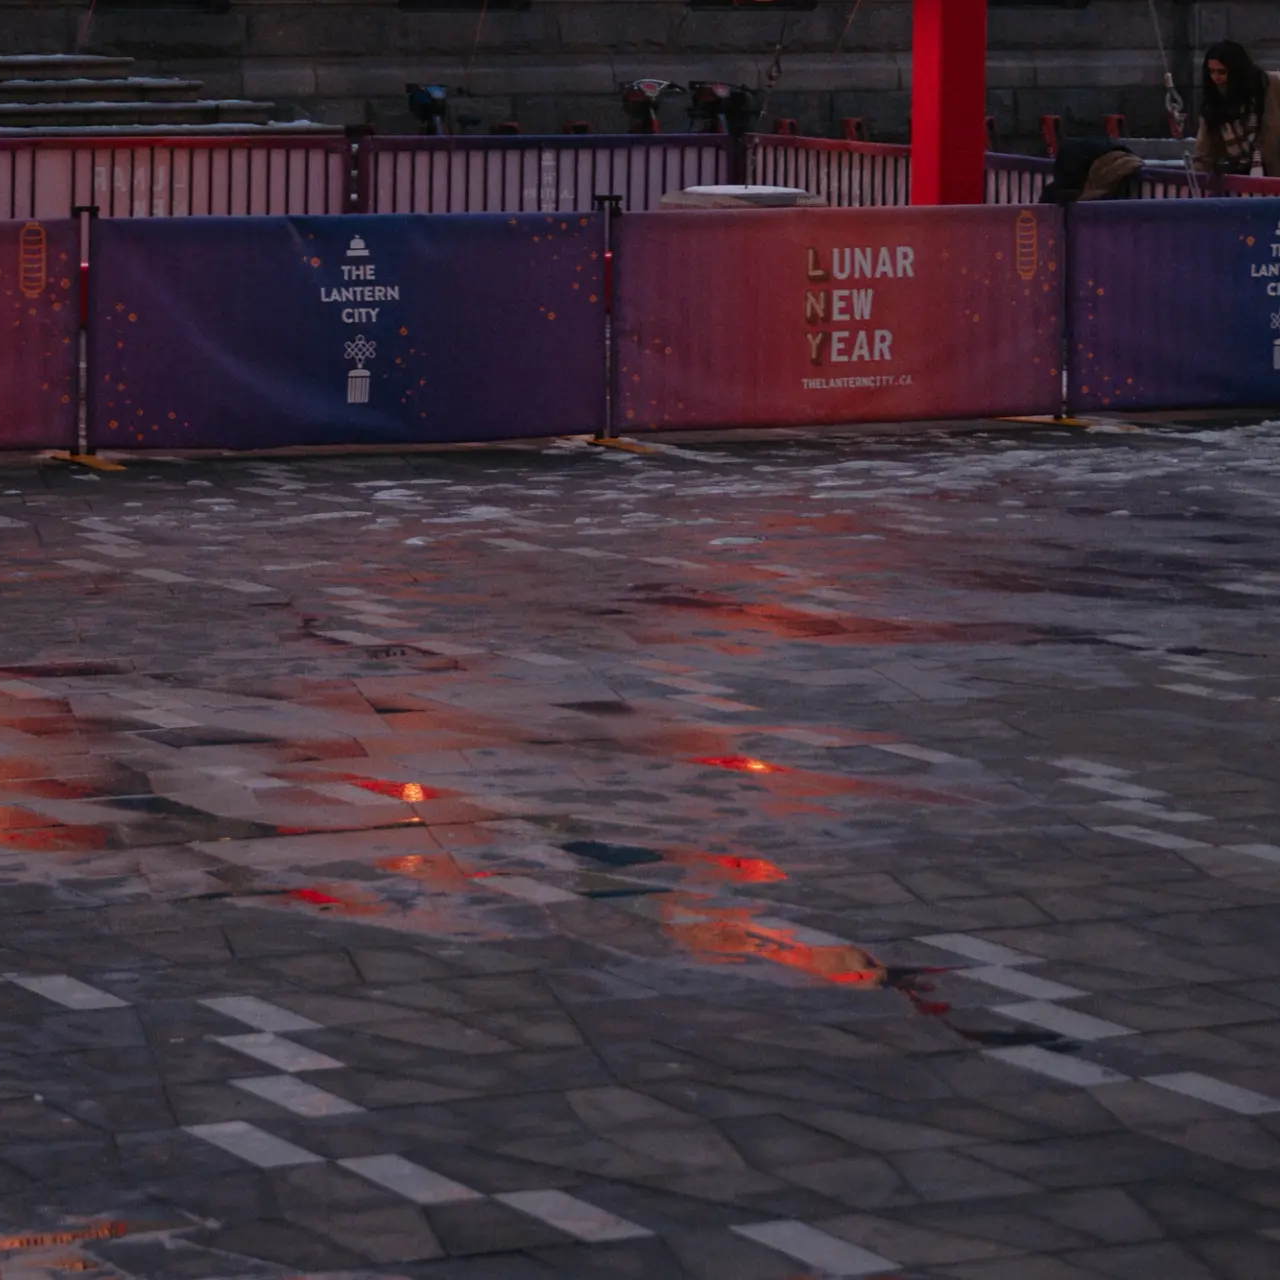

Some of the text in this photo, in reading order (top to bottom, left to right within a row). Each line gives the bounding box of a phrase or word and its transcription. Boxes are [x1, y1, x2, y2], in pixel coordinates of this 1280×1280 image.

[807, 245, 916, 281] LUNAR
[340, 264, 377, 281] THE
[319, 285, 401, 303] LANTERN
[805, 288, 874, 322] NEW
[341, 307, 381, 324] CITY
[805, 329, 894, 363] YEAR
[801, 374, 914, 390] THELANTERNCITY.CA
